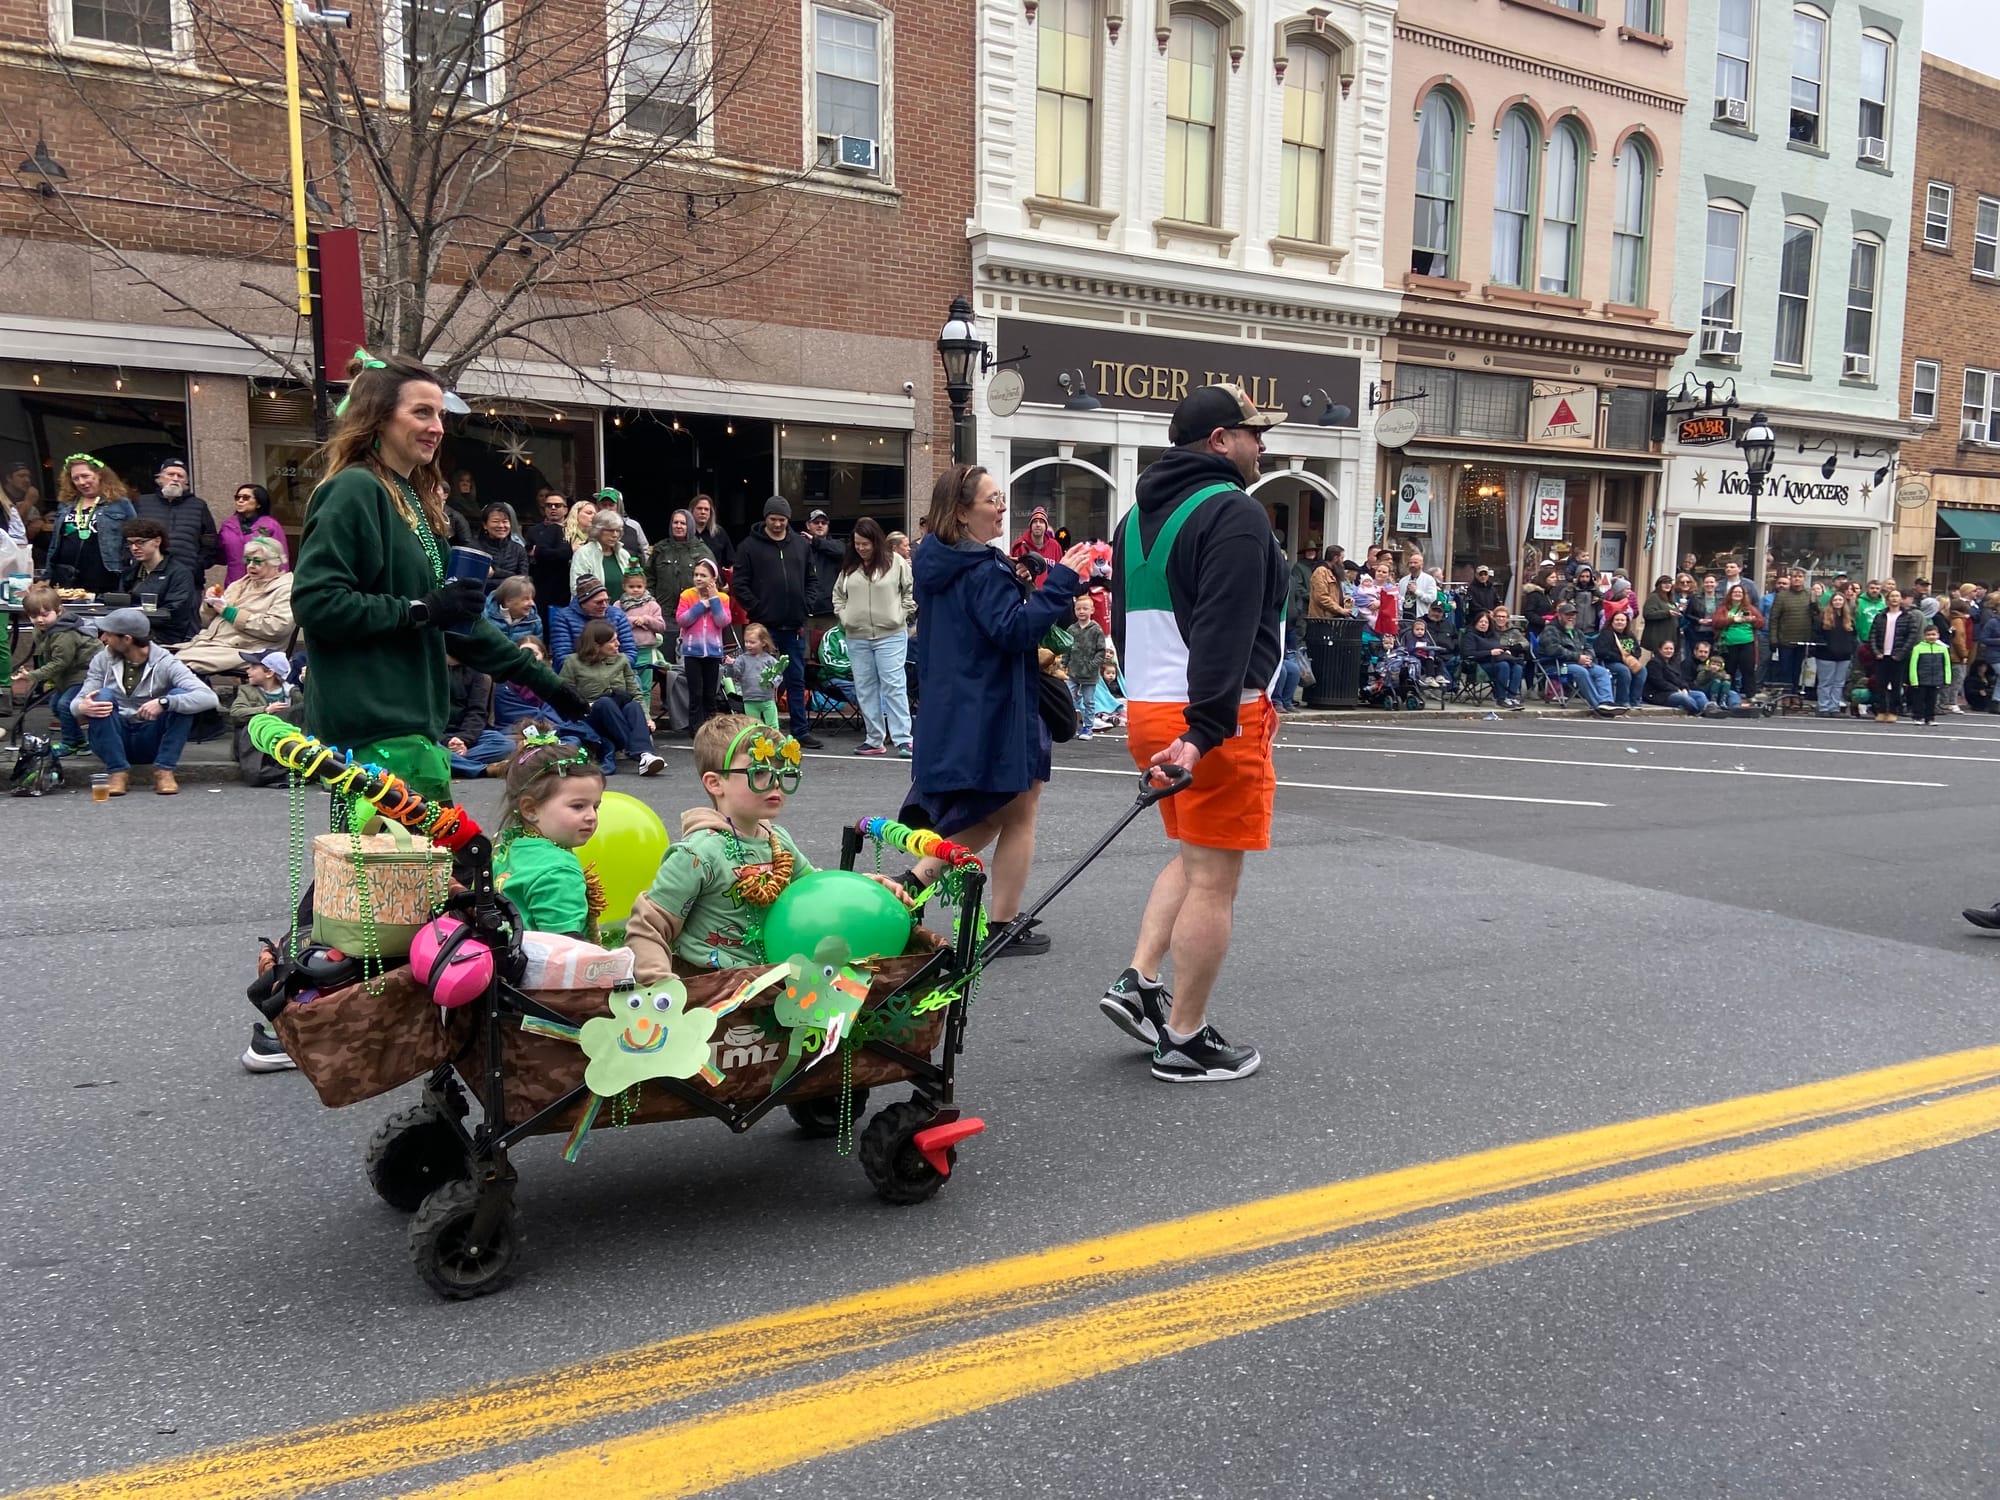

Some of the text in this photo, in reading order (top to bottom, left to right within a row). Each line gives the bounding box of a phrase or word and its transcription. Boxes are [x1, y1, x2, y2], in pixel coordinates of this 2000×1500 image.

[1092, 360, 1190, 401] TIGER
[1541, 422, 1582, 438] ATTIC
[1681, 417, 1728, 438] SWBR
[273, 466, 297, 477] 522
[1783, 480, 1850, 506] KNOCKERS
[1542, 503, 1558, 522] $5
